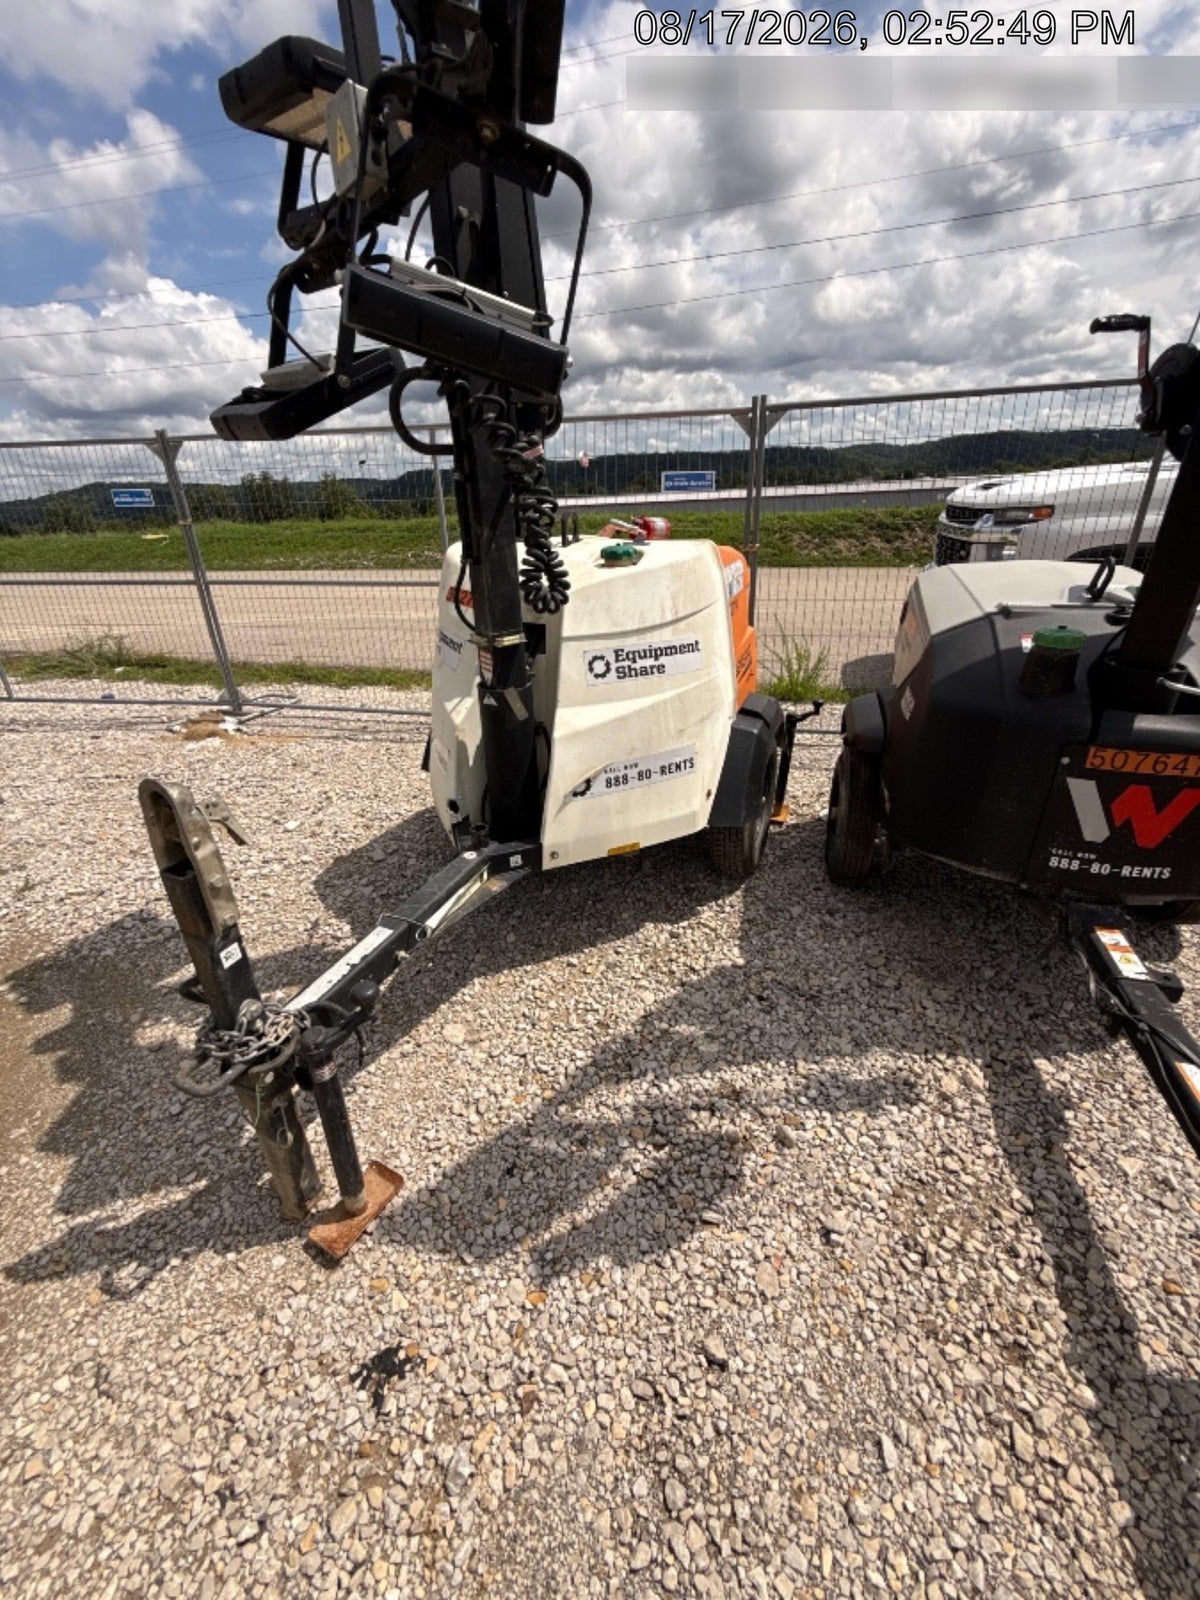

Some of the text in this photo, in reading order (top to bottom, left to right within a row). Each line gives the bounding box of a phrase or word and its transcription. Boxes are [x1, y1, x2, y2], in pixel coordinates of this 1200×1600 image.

[613, 640, 700, 663] Equipment
[615, 663, 665, 680] Share
[605, 757, 694, 788] 888-80-RENTS
[1049, 856, 1172, 879] 888-80-RENTS
